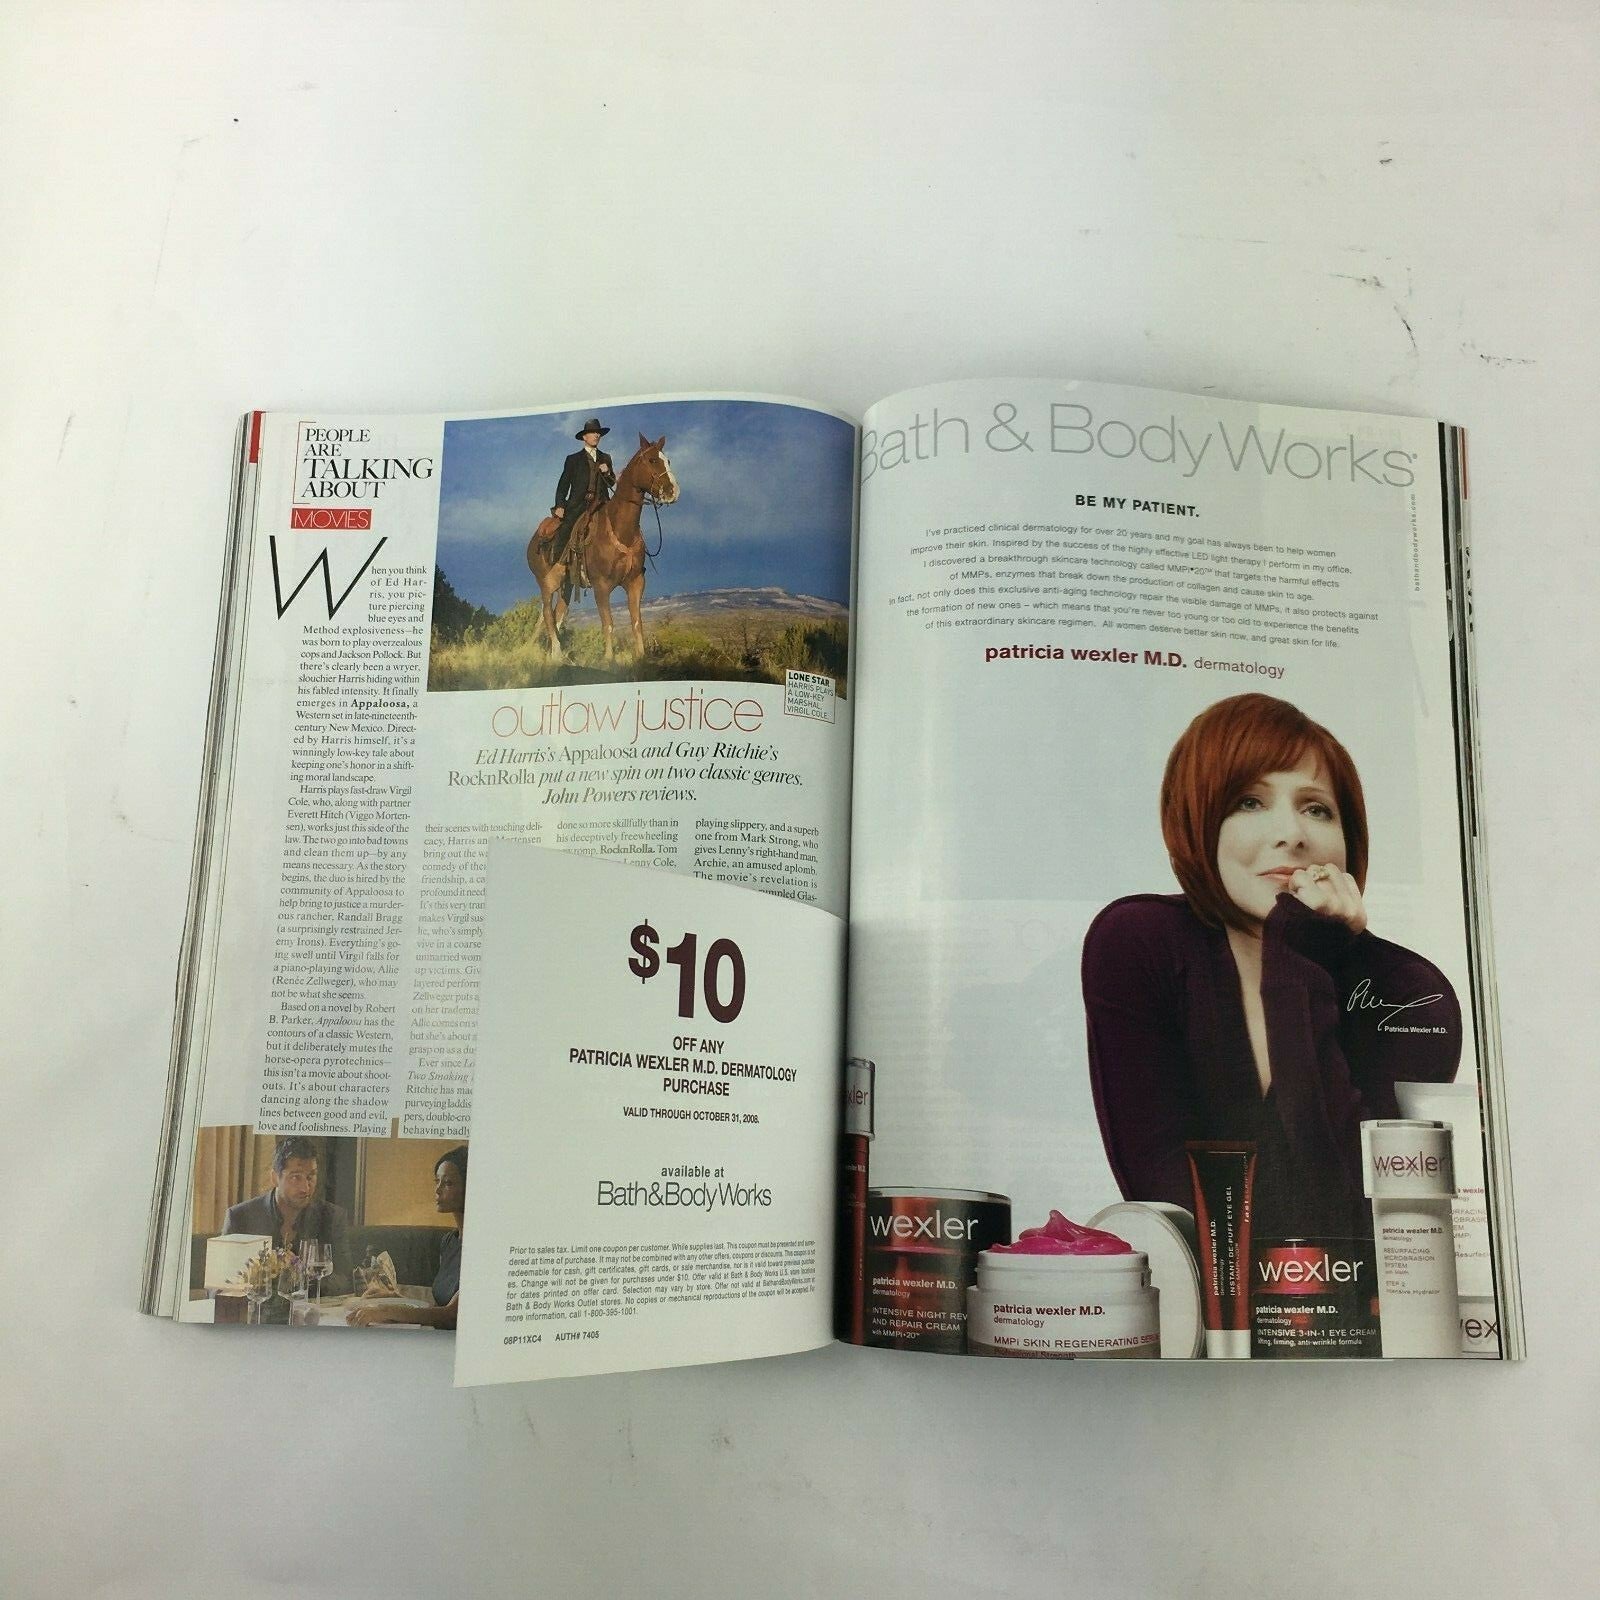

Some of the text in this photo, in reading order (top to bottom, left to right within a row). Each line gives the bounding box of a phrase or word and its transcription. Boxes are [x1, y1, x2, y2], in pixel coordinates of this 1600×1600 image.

[305, 429, 370, 442] PEOPLE
[986, 403, 1033, 452] &
[1050, 403, 1212, 477] Body
[304, 444, 342, 456] ARE
[303, 458, 433, 479] TALKING
[301, 481, 385, 498] ABOUT
[1075, 495, 1199, 517] BE MY PATIENT.
[294, 510, 369, 528] MOVIES
[943, 525, 985, 535] practiced
[988, 523, 1019, 532] clinical
[1023, 524, 1077, 534] dermatology
[1081, 525, 1092, 533] for
[1095, 528, 1113, 536] over
[1116, 529, 1127, 537] 20
[1130, 531, 1152, 540] years
[1155, 532, 1170, 541] and
[1173, 536, 1184, 545] my
[1187, 536, 1204, 546] goal
[1208, 538, 1221, 547] has
[1224, 541, 1251, 551] always
[1253, 543, 1273, 552] been
[1276, 544, 1284, 553] to
[1287, 546, 1304, 556] help
[1306, 549, 1335, 557] women
[388, 567, 404, 577] you
[406, 566, 427, 574] think
[985, 644, 1285, 679] patricia wexler M.D. dermatology
[789, 672, 829, 687] LONE STAR
[788, 682, 833, 696] HARRIS PLAYS
[795, 691, 824, 702] LOW-KEY
[492, 687, 763, 744] outlaw justice
[787, 705, 810, 715] VIRGIL
[476, 742, 778, 765] Ed Harris's Appaloosa and Guy Ritchie's
[448, 763, 803, 787] RocknRolla put a new spin on two classic genres.
[542, 787, 697, 804] John Powers reviews.
[695, 832, 818, 849] one from Mark Strong, who
[628, 918, 747, 1025] $10
[673, 1036, 724, 1054] OFF ANY
[569, 1048, 797, 1082] PATRICIA WEXLER M.D. DERMATOLOGY
[663, 1078, 730, 1096] PURCHASE
[260, 1108, 281, 1117] lines
[283, 1108, 322, 1118] between
[324, 1110, 347, 1120] good
[350, 1111, 367, 1120] and
[623, 1106, 759, 1124] VALID THROUGH OCTOBER 31, 2008.
[1374, 1151, 1445, 1171] wexler
[661, 1165, 724, 1178] available at
[870, 1210, 978, 1240] wexler
[510, 1246, 527, 1255] Prior
[572, 1245, 587, 1253] Limit
[603, 1245, 627, 1254] coupon
[629, 1245, 639, 1253] per
[641, 1244, 669, 1252] customer.
[1259, 1254, 1363, 1282] wexler
[873, 1277, 958, 1289] patricia wexler M.D.
[872, 1288, 910, 1298] dermatology
[872, 1307, 914, 1317] INTENSIVE
[916, 1311, 947, 1320] NIGHT
[994, 1304, 1105, 1316] patricia wexler M.D.
[1256, 1306, 1338, 1314] patricia wexler M.D.
[872, 1318, 960, 1331] AND REPAIR CREAM
[994, 1316, 1044, 1328] dermatology
[1257, 1317, 1291, 1325] dermatology
[555, 1332, 580, 1342] AUTH#
[583, 1331, 599, 1340] 7405
[1258, 1329, 1296, 1337] INTENSIVE
[1299, 1329, 1325, 1337] 3-IN-1
[1023, 1338, 1050, 1347] SKIN
[1055, 1336, 1138, 1348] REGENERATING
[1298, 1337, 1336, 1346] anti-wrinkle
[1339, 1337, 1362, 1345] formula
